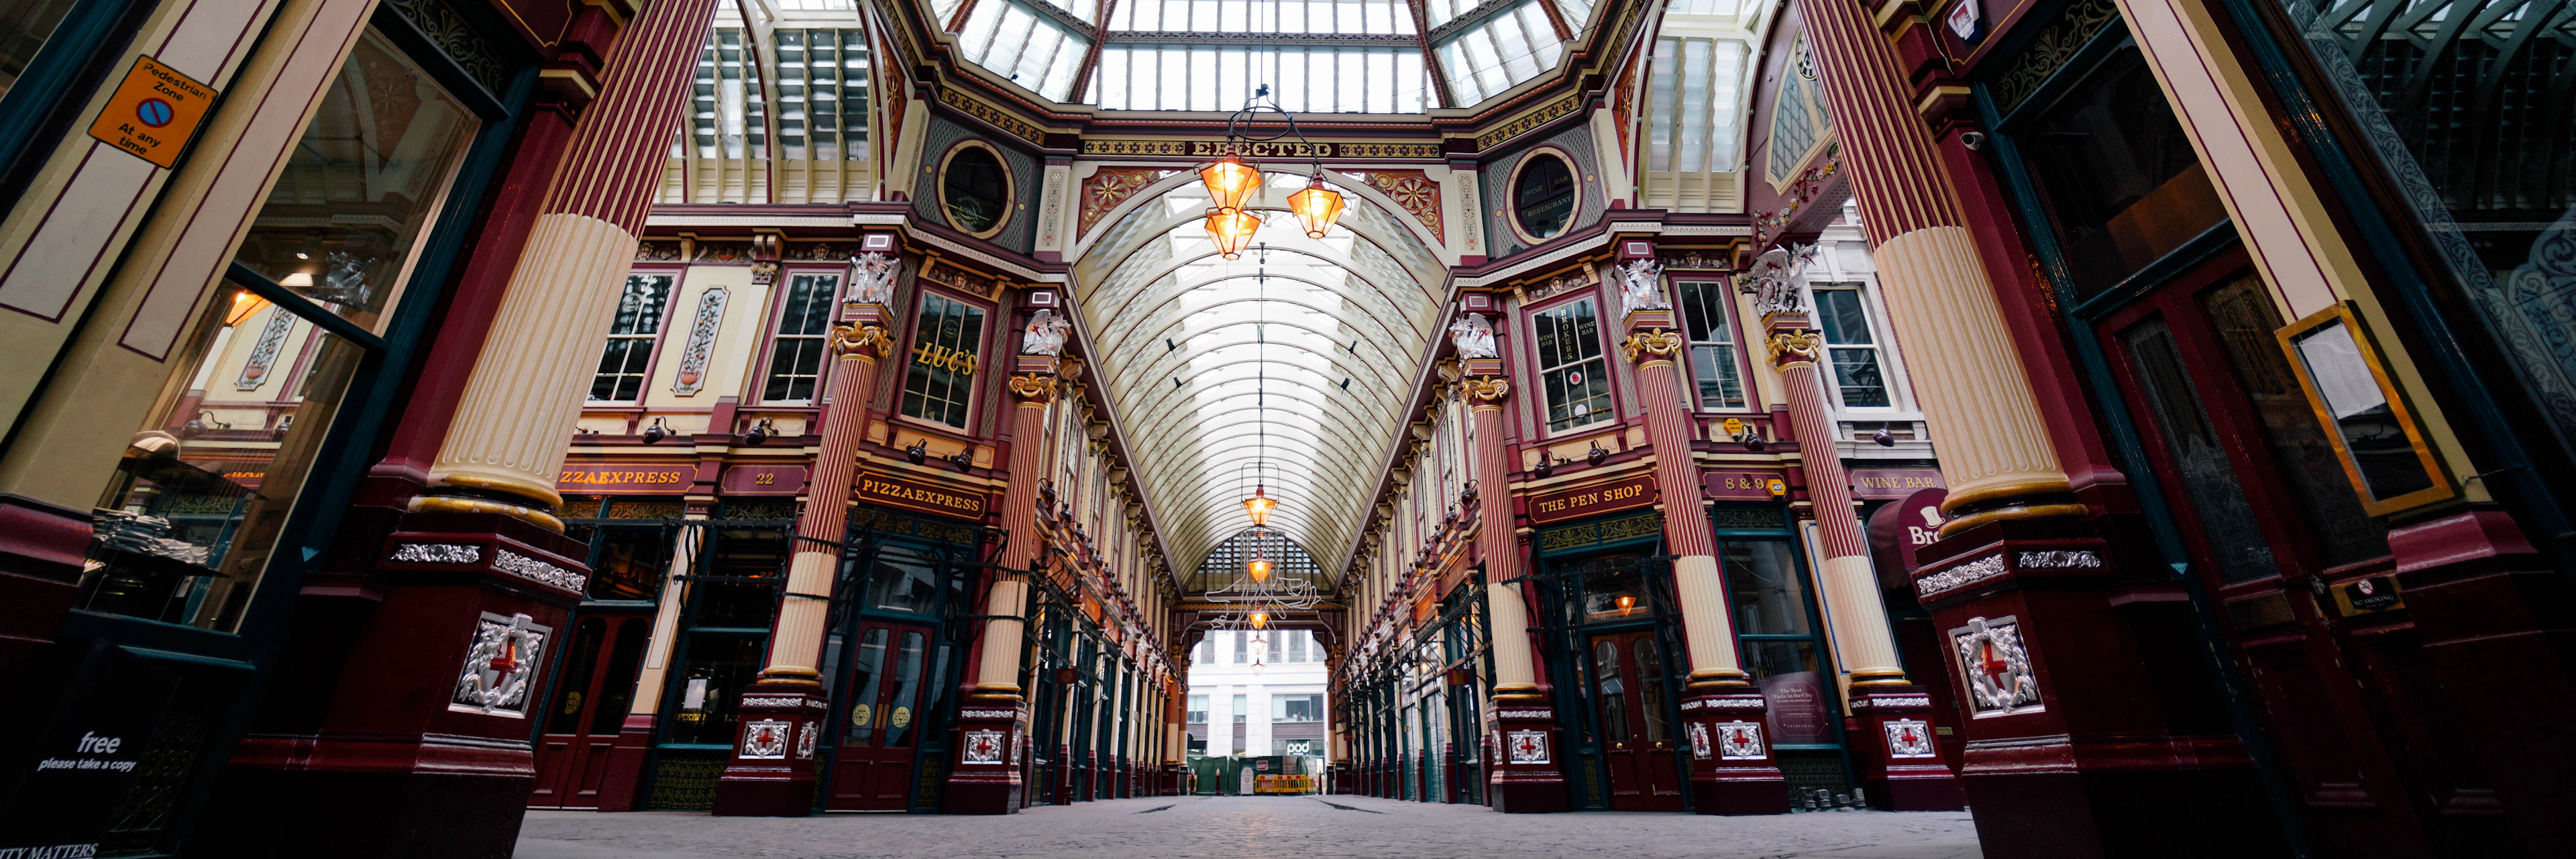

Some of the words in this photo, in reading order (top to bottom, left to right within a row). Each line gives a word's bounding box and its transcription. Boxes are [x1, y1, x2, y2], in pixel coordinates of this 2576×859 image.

[143, 62, 207, 99] Pedestrian
[153, 81, 184, 101] Zone
[117, 123, 135, 136] At
[138, 134, 161, 148] any
[119, 136, 148, 155] time
[1192, 142, 1332, 156] ERECTED
[1525, 185, 1544, 196] WINE
[1554, 175, 1568, 185] BAR
[1527, 195, 1572, 217] RESTAURANT
[1560, 309, 1573, 360] BROKERS
[1578, 321, 1595, 330] WINE
[1581, 327, 1594, 336] BAR
[1538, 333, 1554, 342] WINE
[917, 342, 977, 375] LUC'S
[755, 473, 774, 485] 22
[1725, 478, 1735, 489] 8
[1739, 478, 1752, 490] &
[1754, 478, 1765, 490] 9
[1860, 477, 1902, 489] WINE
[1904, 477, 1937, 489] BAR
[862, 479, 979, 511] PIZZAEXPRESS
[1539, 499, 1566, 513] THE
[1570, 493, 1599, 508] PEN
[1604, 485, 1643, 502] SHOP
[2363, 595, 2394, 604] SMOKING
[76, 731, 121, 754] free
[1287, 740, 1310, 756] pod
[37, 758, 76, 772] please
[77, 758, 101, 770] take
[101, 761, 109, 770] a
[110, 761, 137, 772] copy
[28, 842, 101, 859] MATTERS
